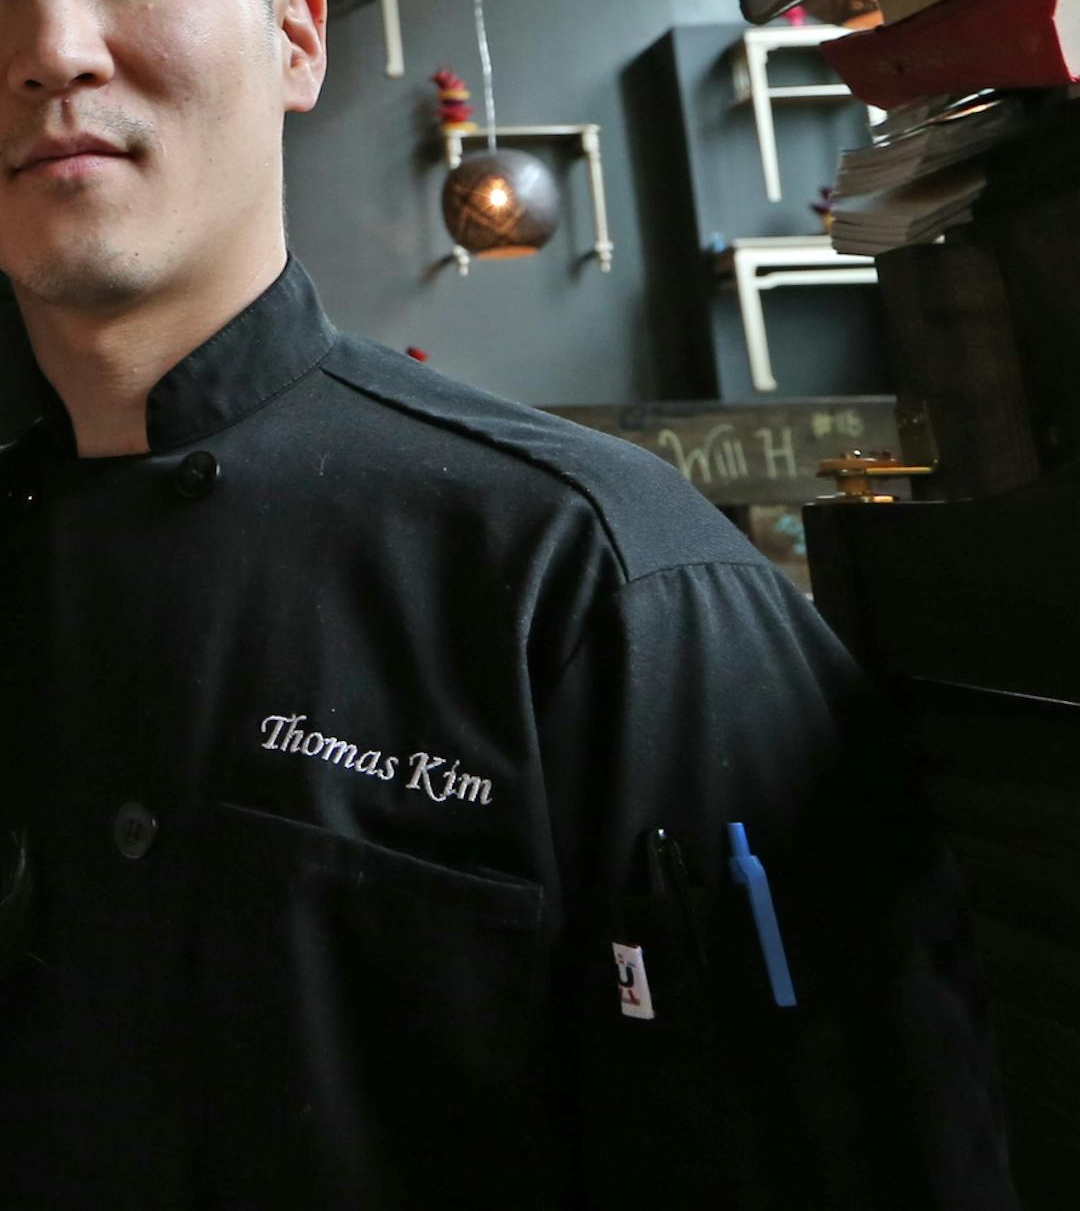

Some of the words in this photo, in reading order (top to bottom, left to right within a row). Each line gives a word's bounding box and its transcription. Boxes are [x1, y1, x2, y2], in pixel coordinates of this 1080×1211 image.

[658, 423, 749, 484] Will
[753, 426, 797, 479] H
[260, 713, 400, 780] Thomas
[404, 751, 493, 806] Kim
